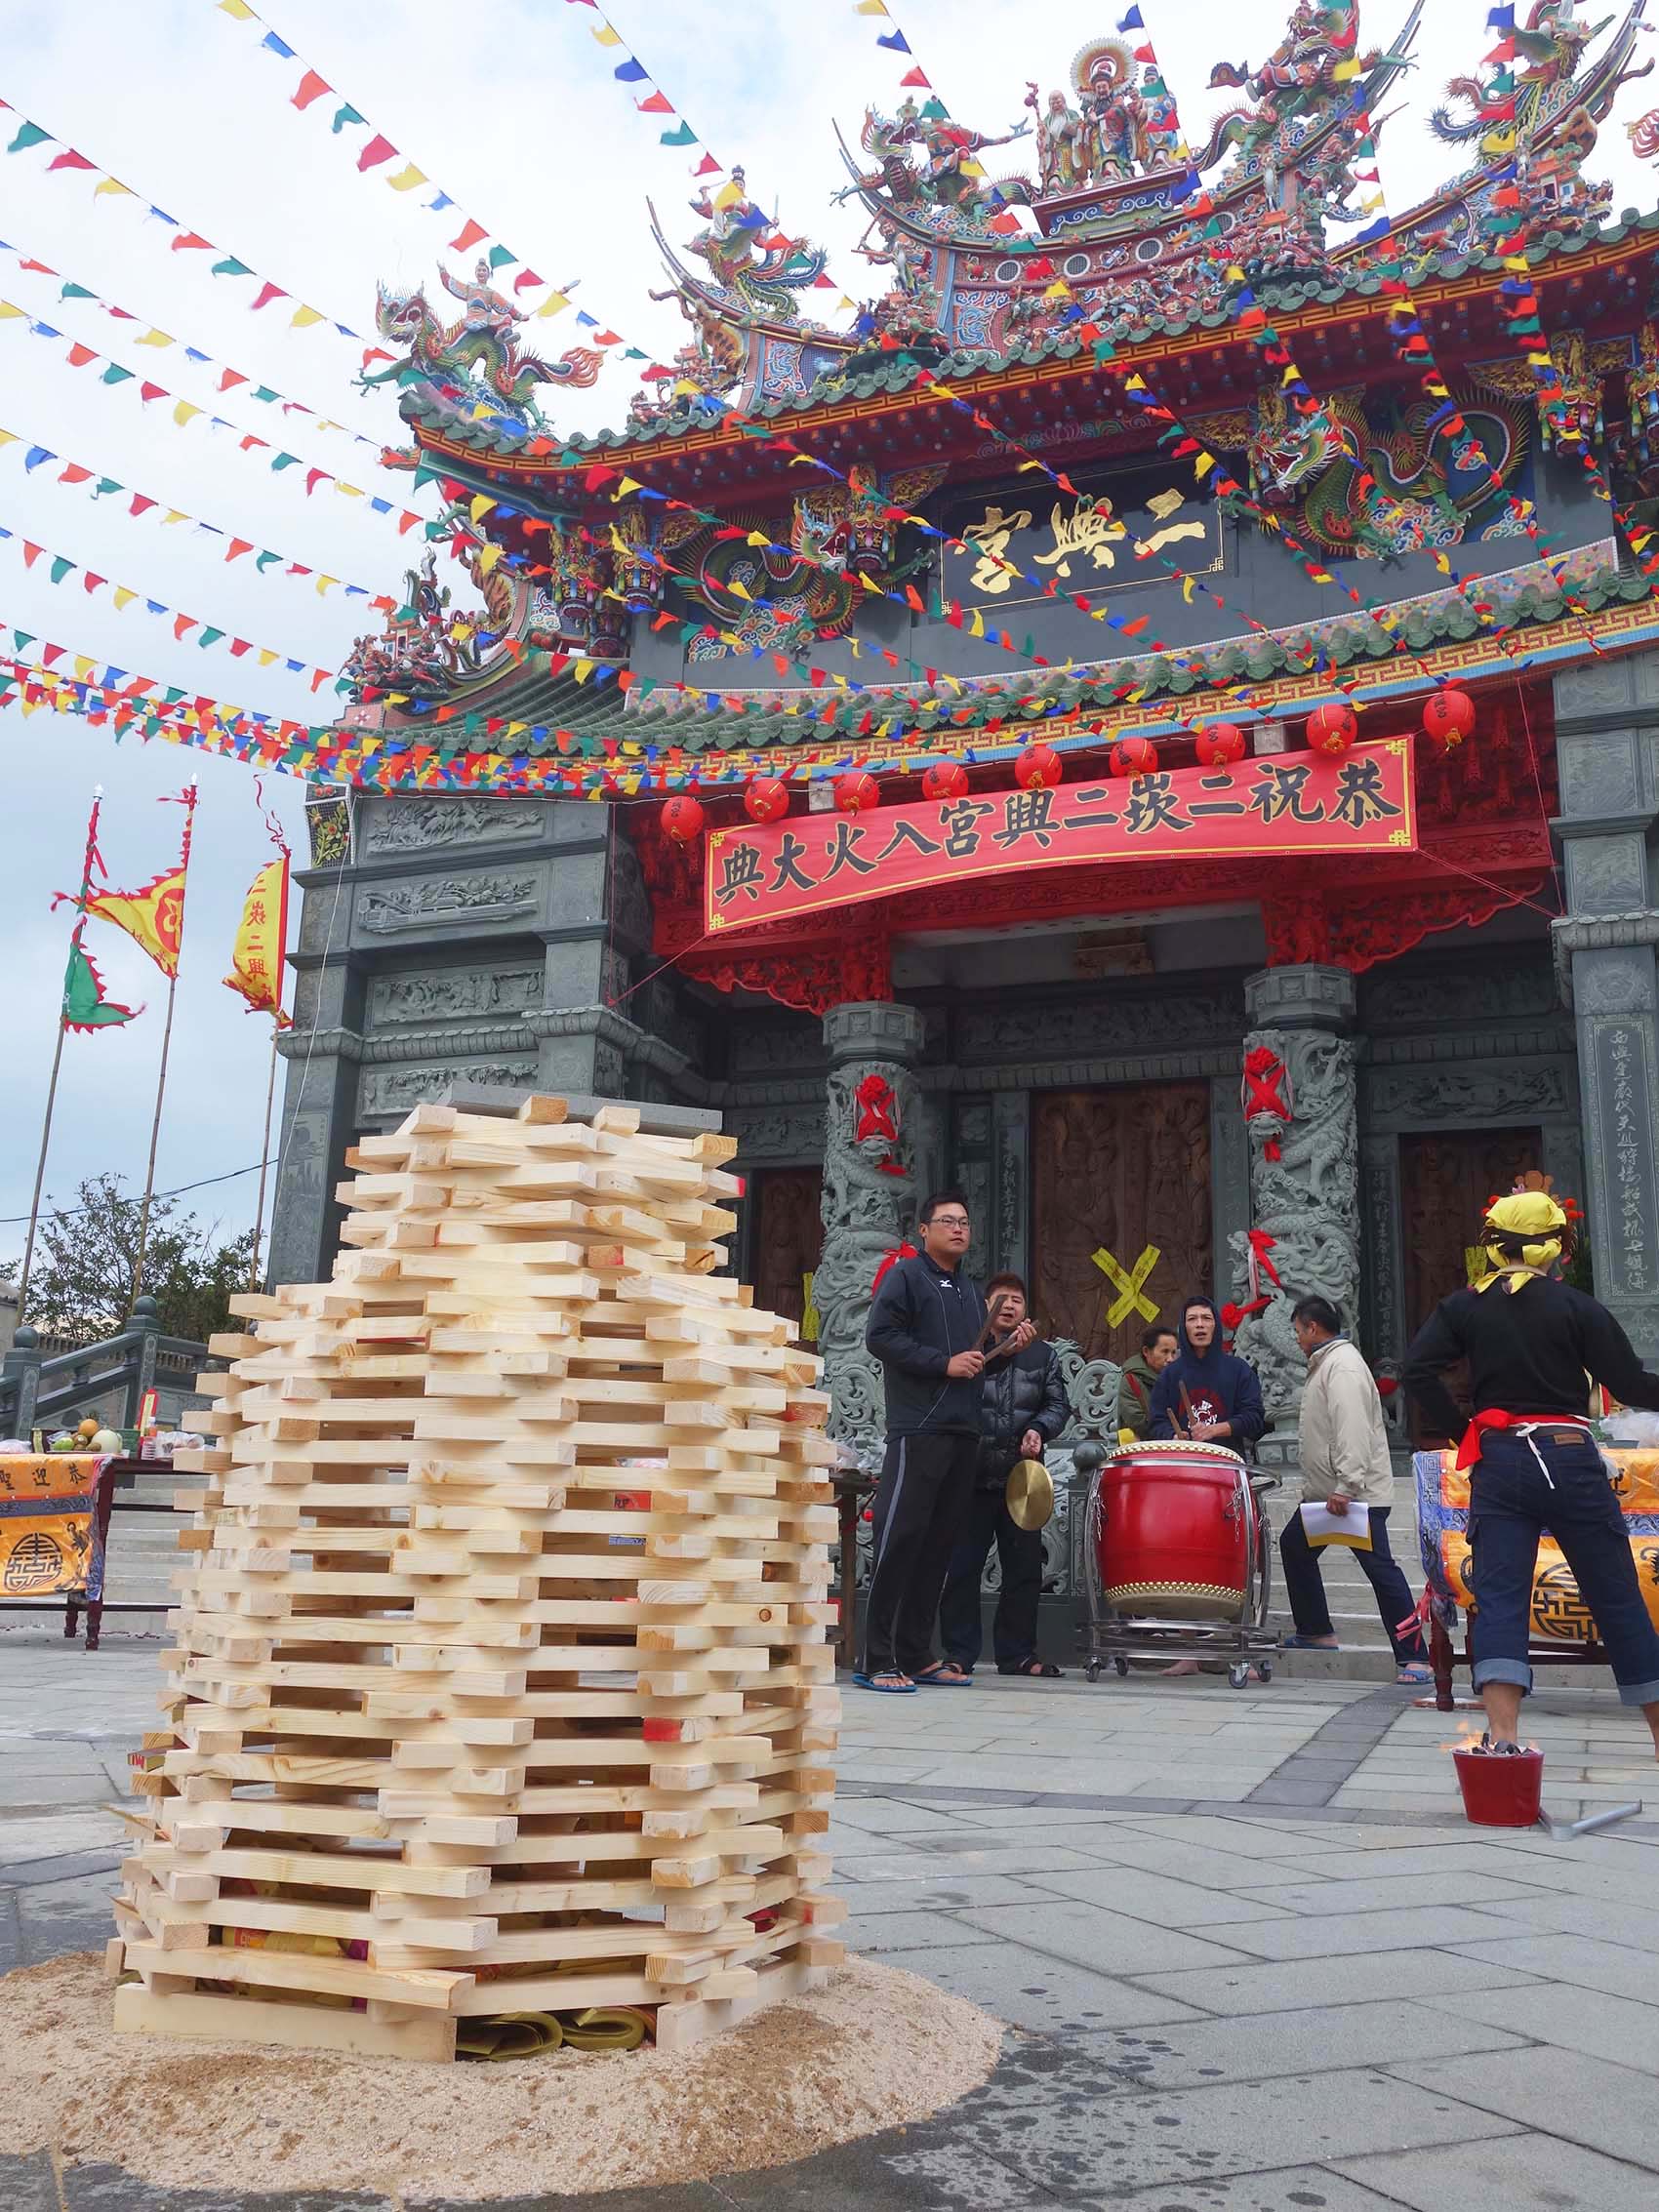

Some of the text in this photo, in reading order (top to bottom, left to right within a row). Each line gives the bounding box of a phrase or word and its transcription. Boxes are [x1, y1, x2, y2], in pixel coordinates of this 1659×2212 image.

[713, 758, 1402, 905] 恭祝二崁二興宮入火大典
[246, 879, 270, 993] 二崁二興
